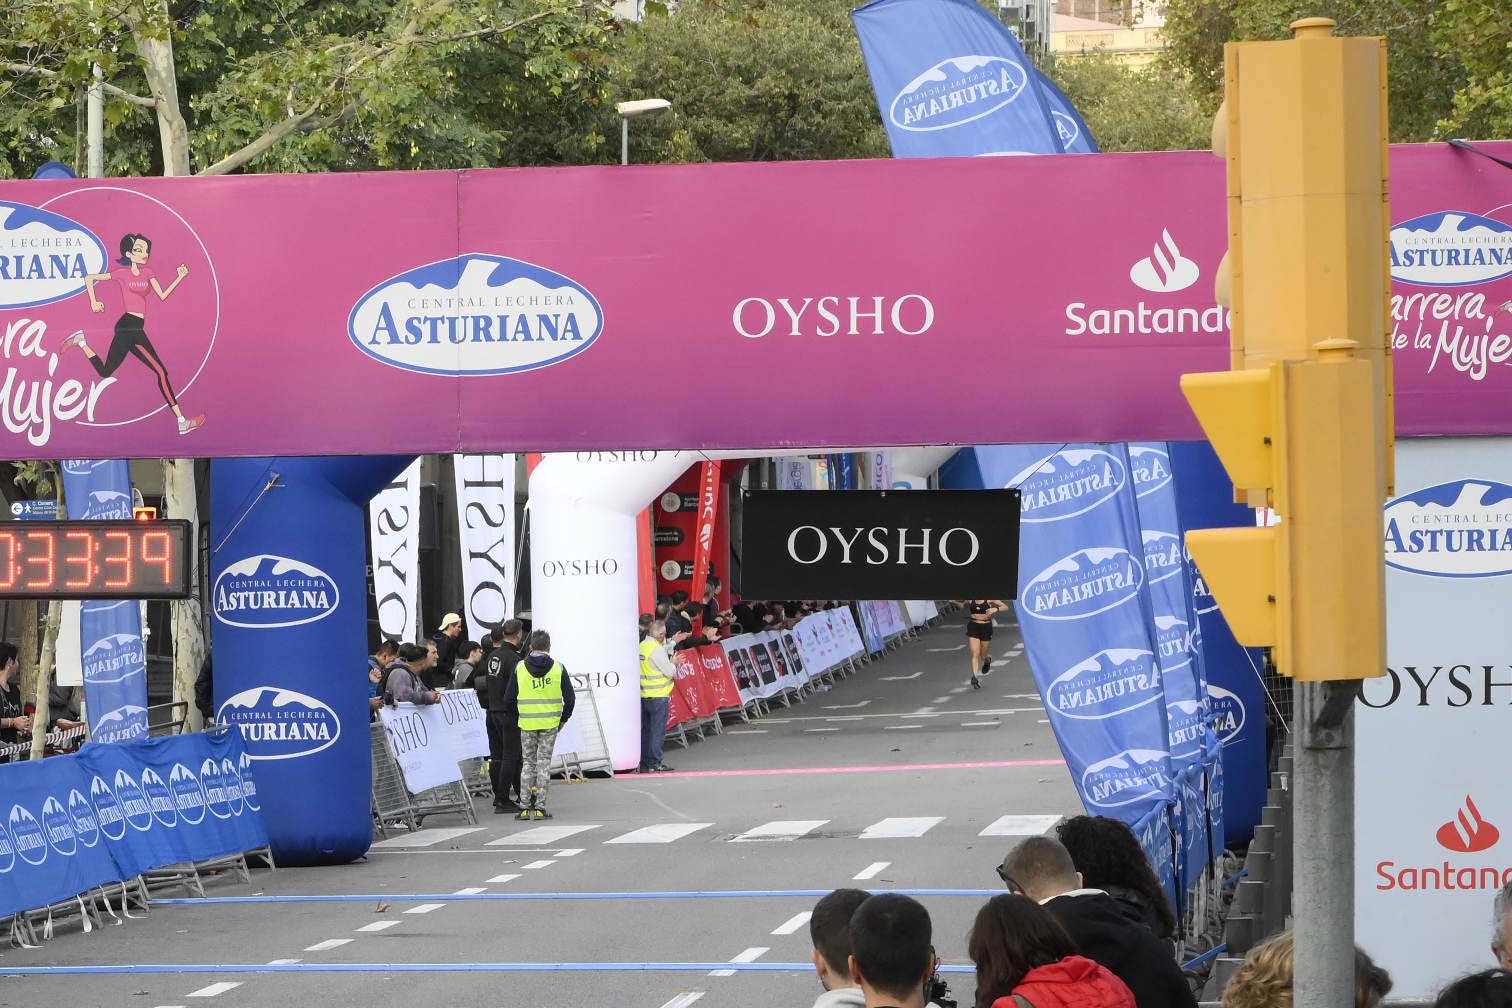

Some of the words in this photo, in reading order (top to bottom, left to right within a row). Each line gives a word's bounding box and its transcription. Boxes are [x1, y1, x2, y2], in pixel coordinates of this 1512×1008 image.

[11, 237, 82, 248] LECHERA
[1405, 237, 1456, 245] CENTRAL
[407, 296, 486, 309] CENTRAL
[494, 294, 575, 307] LECHERA
[1391, 292, 1486, 321] arrera
[368, 301, 583, 345] ASTURIANA
[732, 294, 935, 338] OYSHO
[1414, 322, 1432, 349] la
[1427, 316, 1512, 381] Muje
[1412, 514, 1479, 524] CENTRAL
[787, 525, 980, 566] OYSHO
[543, 558, 618, 578] OYSHO
[229, 580, 271, 589] CENTRAL
[277, 579, 325, 588] LECHERA
[217, 585, 329, 612] ASTURIANA
[532, 676, 552, 690] Life
[232, 712, 272, 720] CENTRAL
[277, 711, 326, 719] LECHERA
